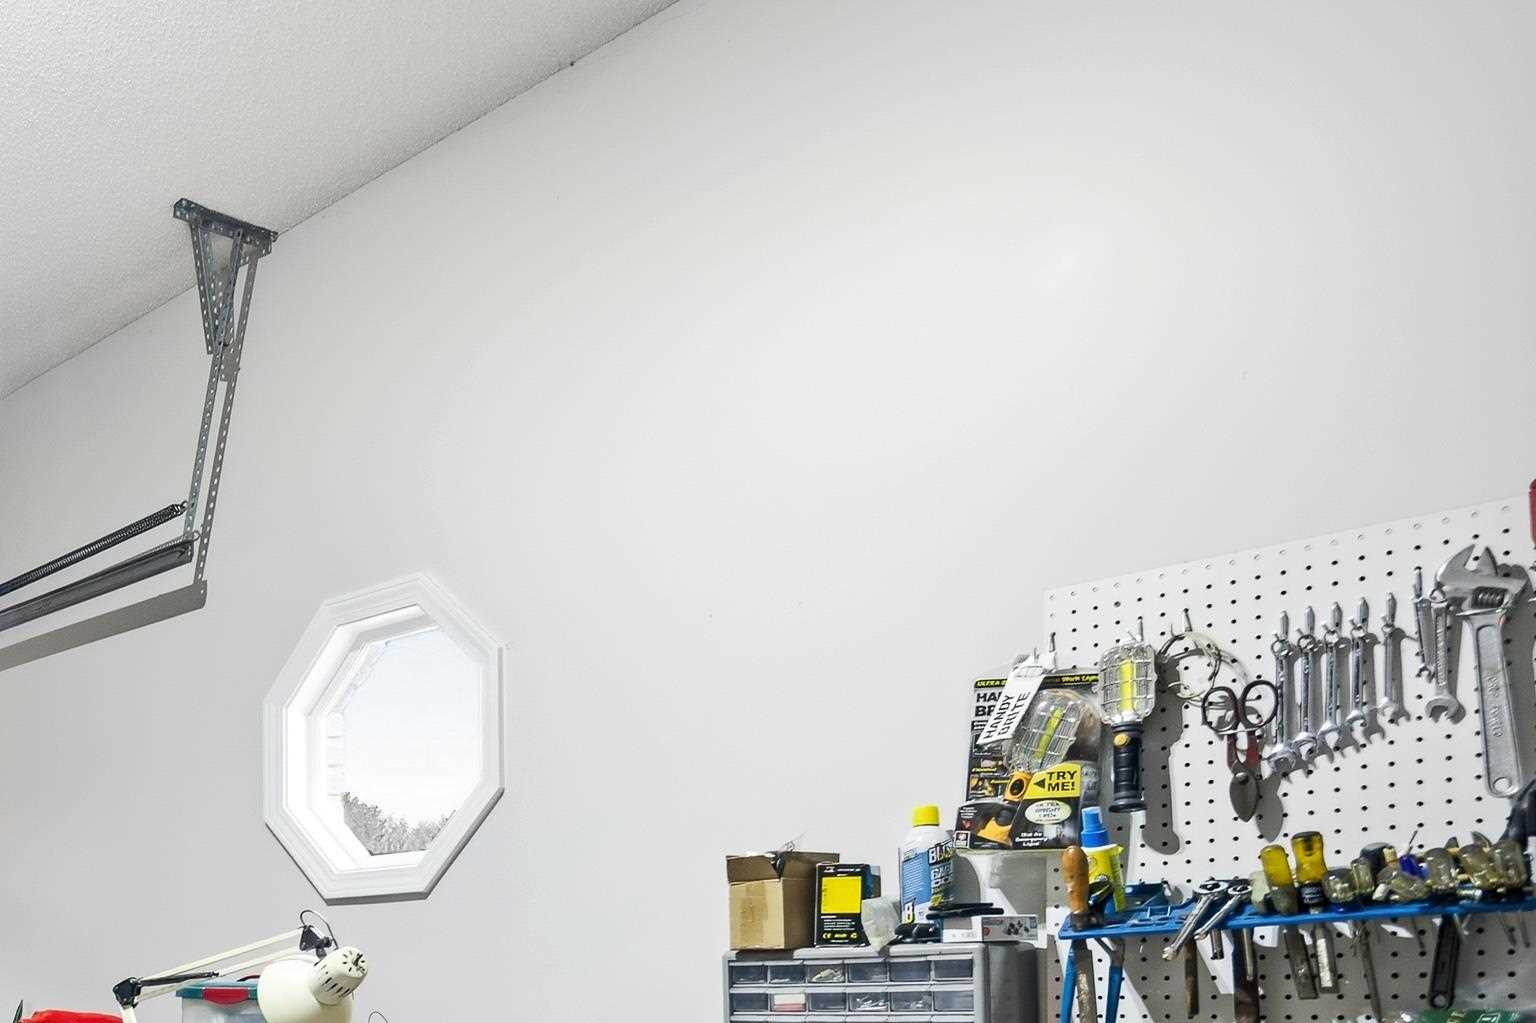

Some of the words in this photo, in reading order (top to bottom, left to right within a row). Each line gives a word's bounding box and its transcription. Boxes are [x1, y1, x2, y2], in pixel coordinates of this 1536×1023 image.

[983, 695, 1014, 739] HANDY
[1047, 771, 1077, 781] TRY
[1047, 781, 1076, 792] ME!
